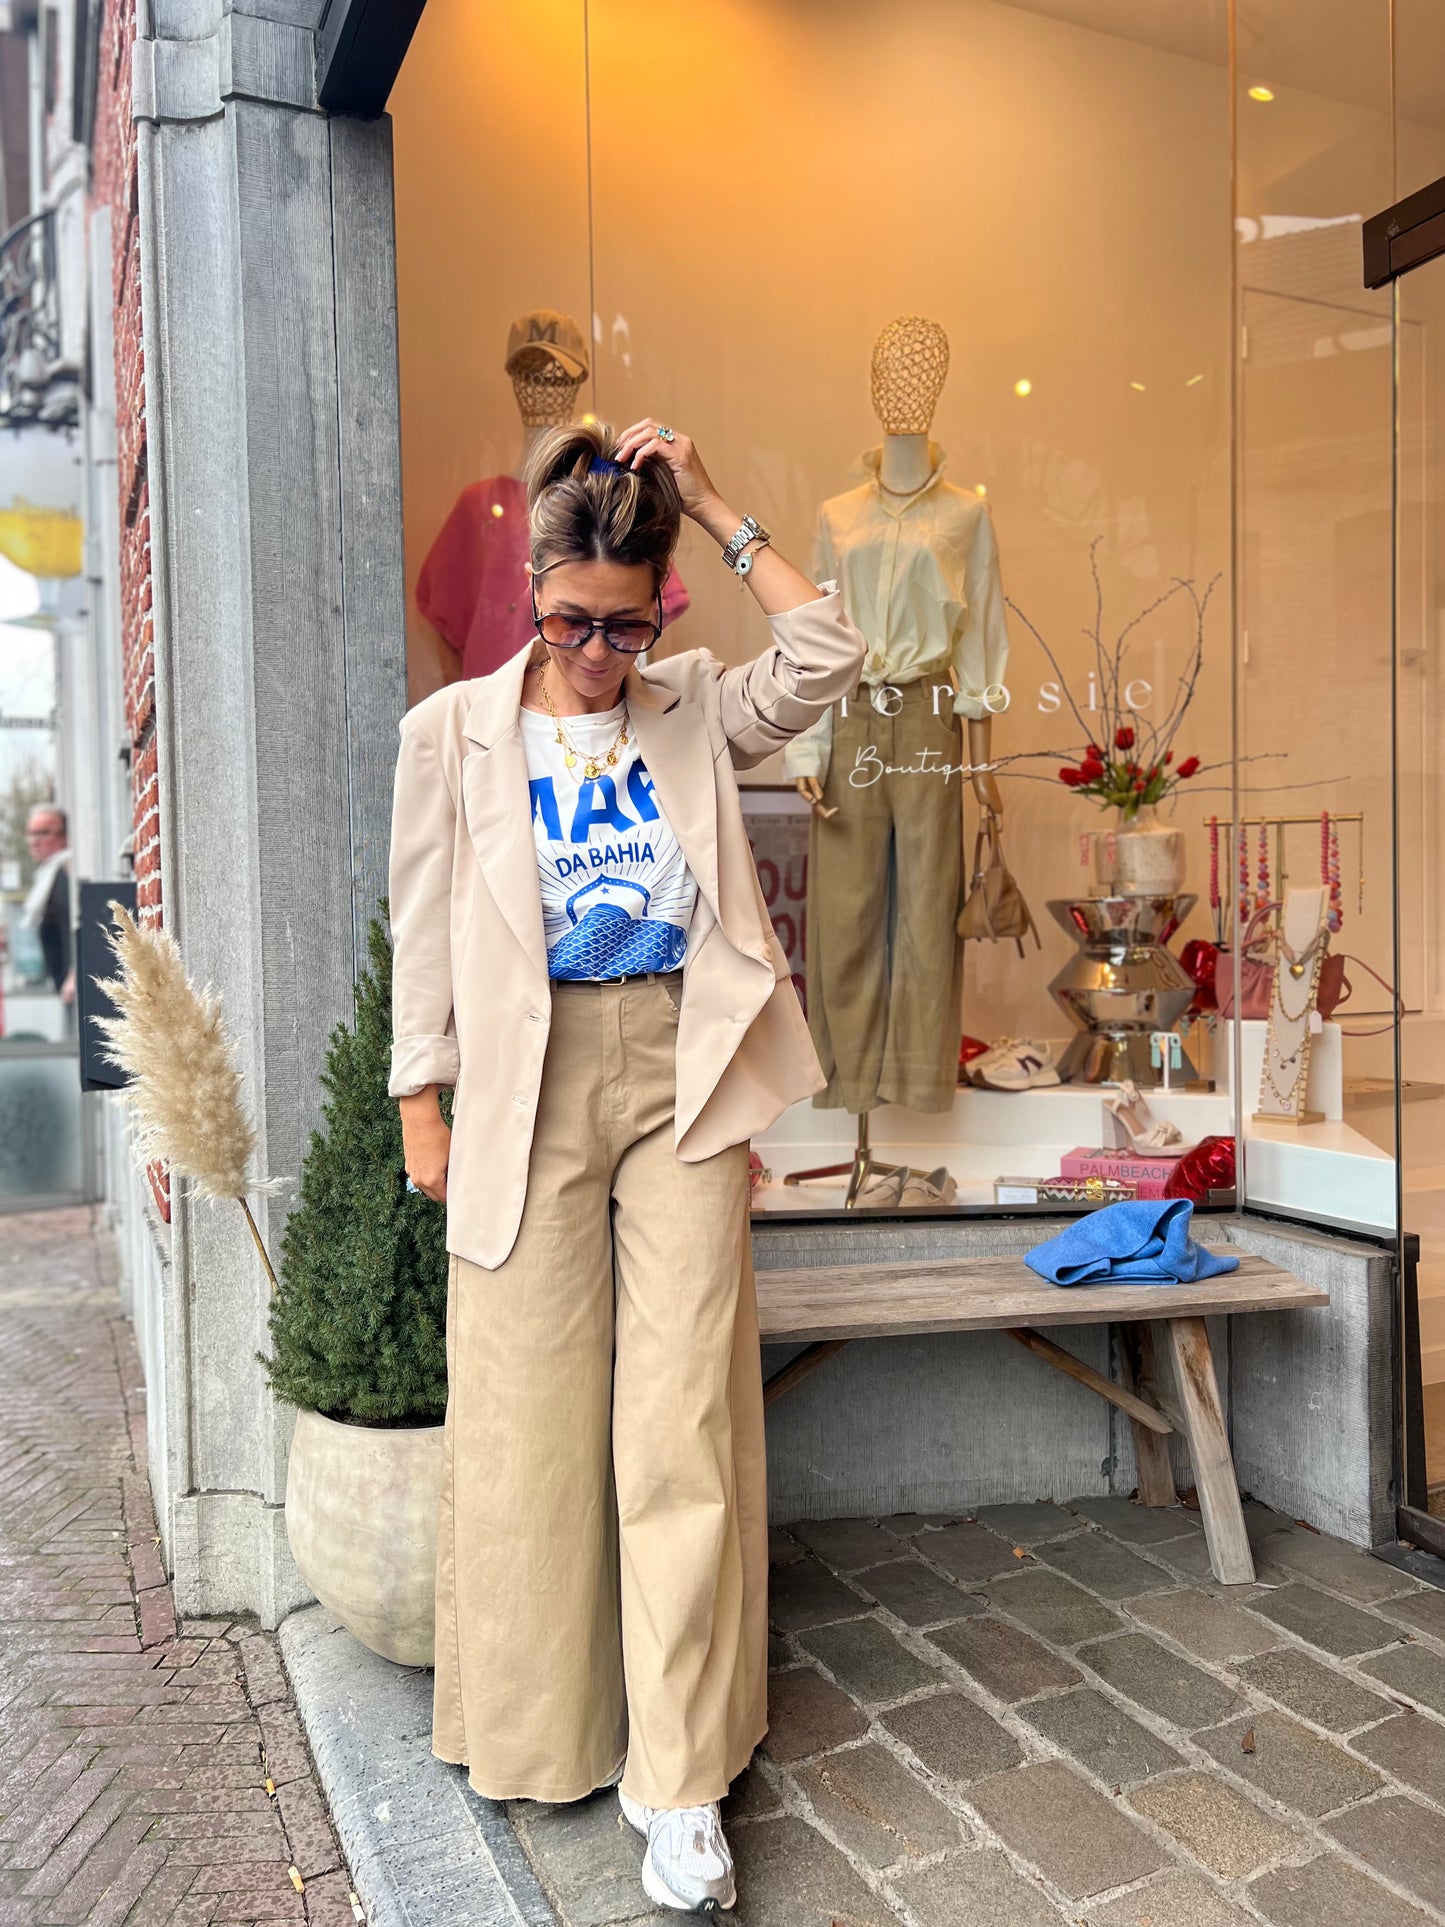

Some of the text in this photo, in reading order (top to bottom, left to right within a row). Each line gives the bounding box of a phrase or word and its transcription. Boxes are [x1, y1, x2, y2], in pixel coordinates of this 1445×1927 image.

[527, 319, 559, 344] M
[849, 745, 999, 788] Boutique
[555, 842, 656, 878] DA BAHIA
